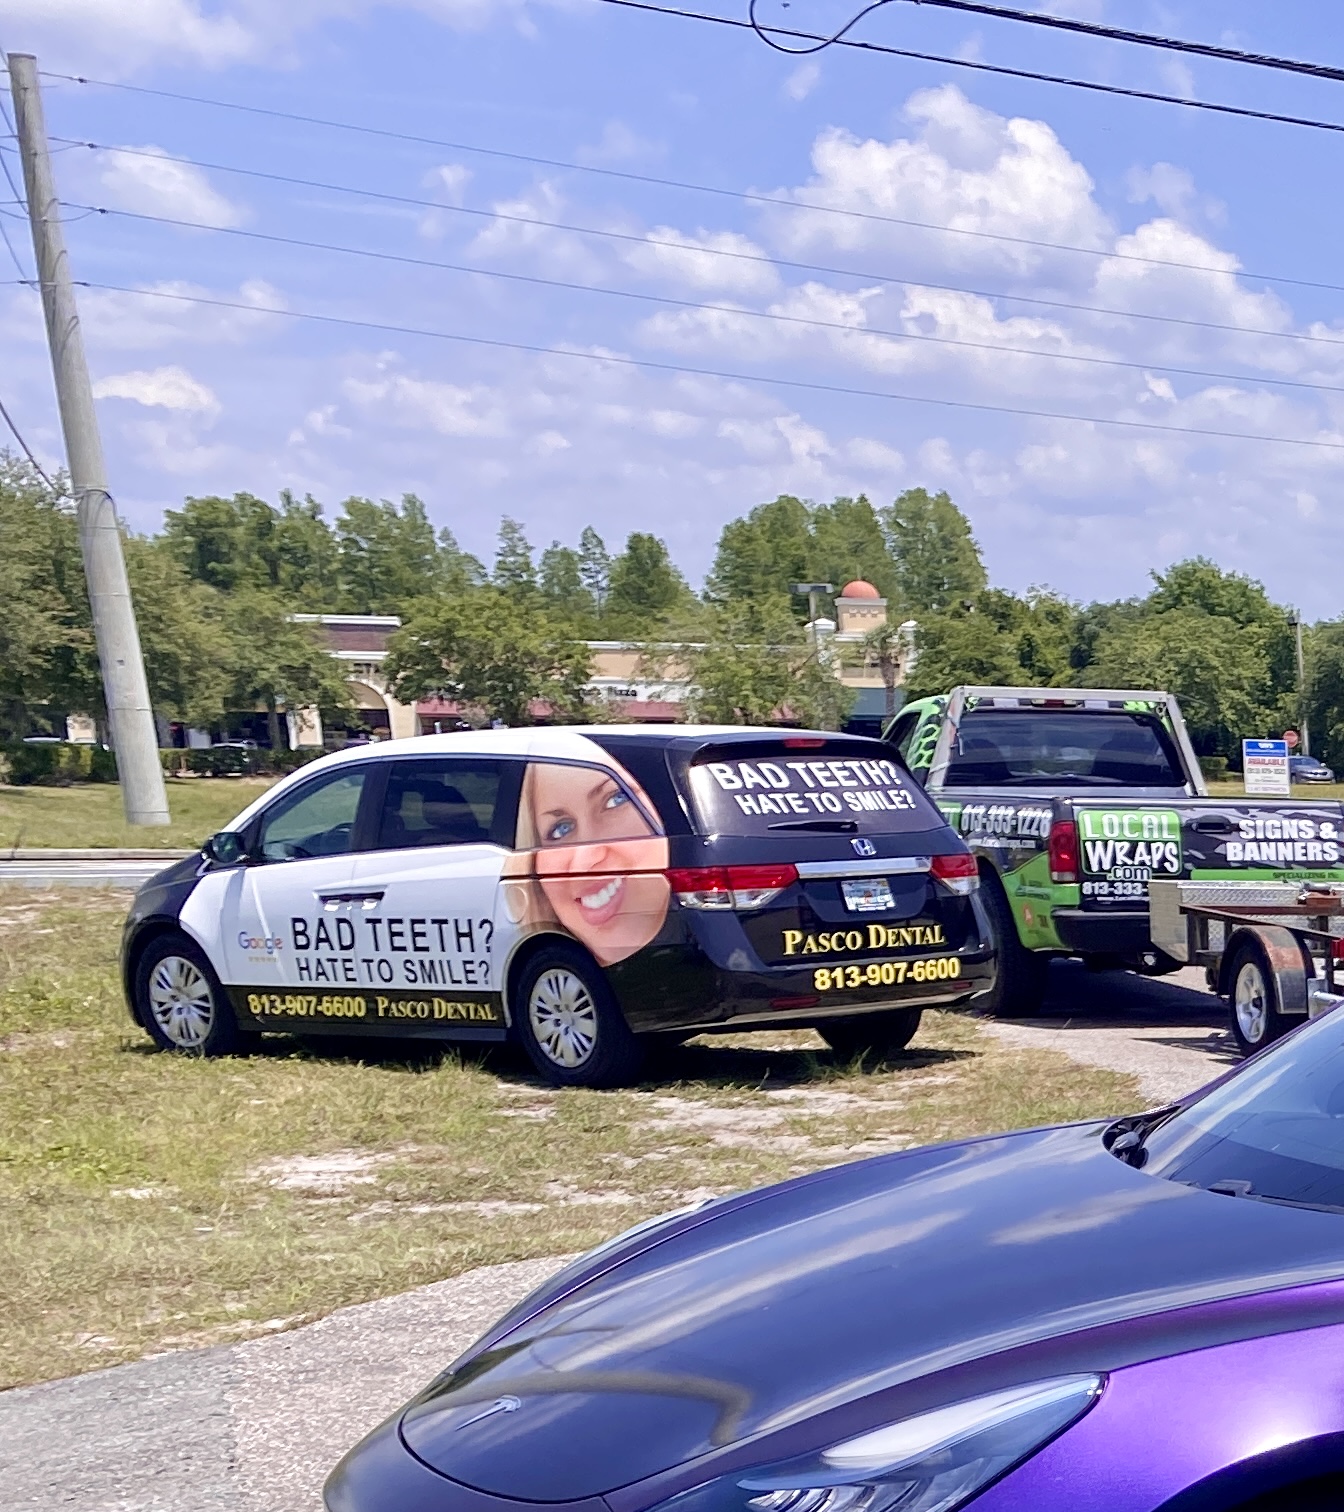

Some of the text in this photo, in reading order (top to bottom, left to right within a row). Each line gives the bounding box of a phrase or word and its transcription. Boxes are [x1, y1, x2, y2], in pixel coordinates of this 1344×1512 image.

[707, 760, 902, 790] BAD TEETH?
[734, 789, 917, 815] HATE TO SMILE?
[1083, 813, 1176, 838] LOCAL
[1238, 819, 1338, 839] SIGNS &
[1085, 840, 1178, 872] WRAPS
[1226, 842, 1339, 861] BANNERS
[1107, 866, 1152, 880] .com
[1082, 881, 1148, 895] 813-333-
[238, 931, 283, 954] Google
[291, 918, 494, 953] BAD TEETH?
[296, 957, 490, 985] HATE TO SMILE?
[814, 957, 961, 991] 813-907-6600
[248, 994, 367, 1017] 813-907-6600
